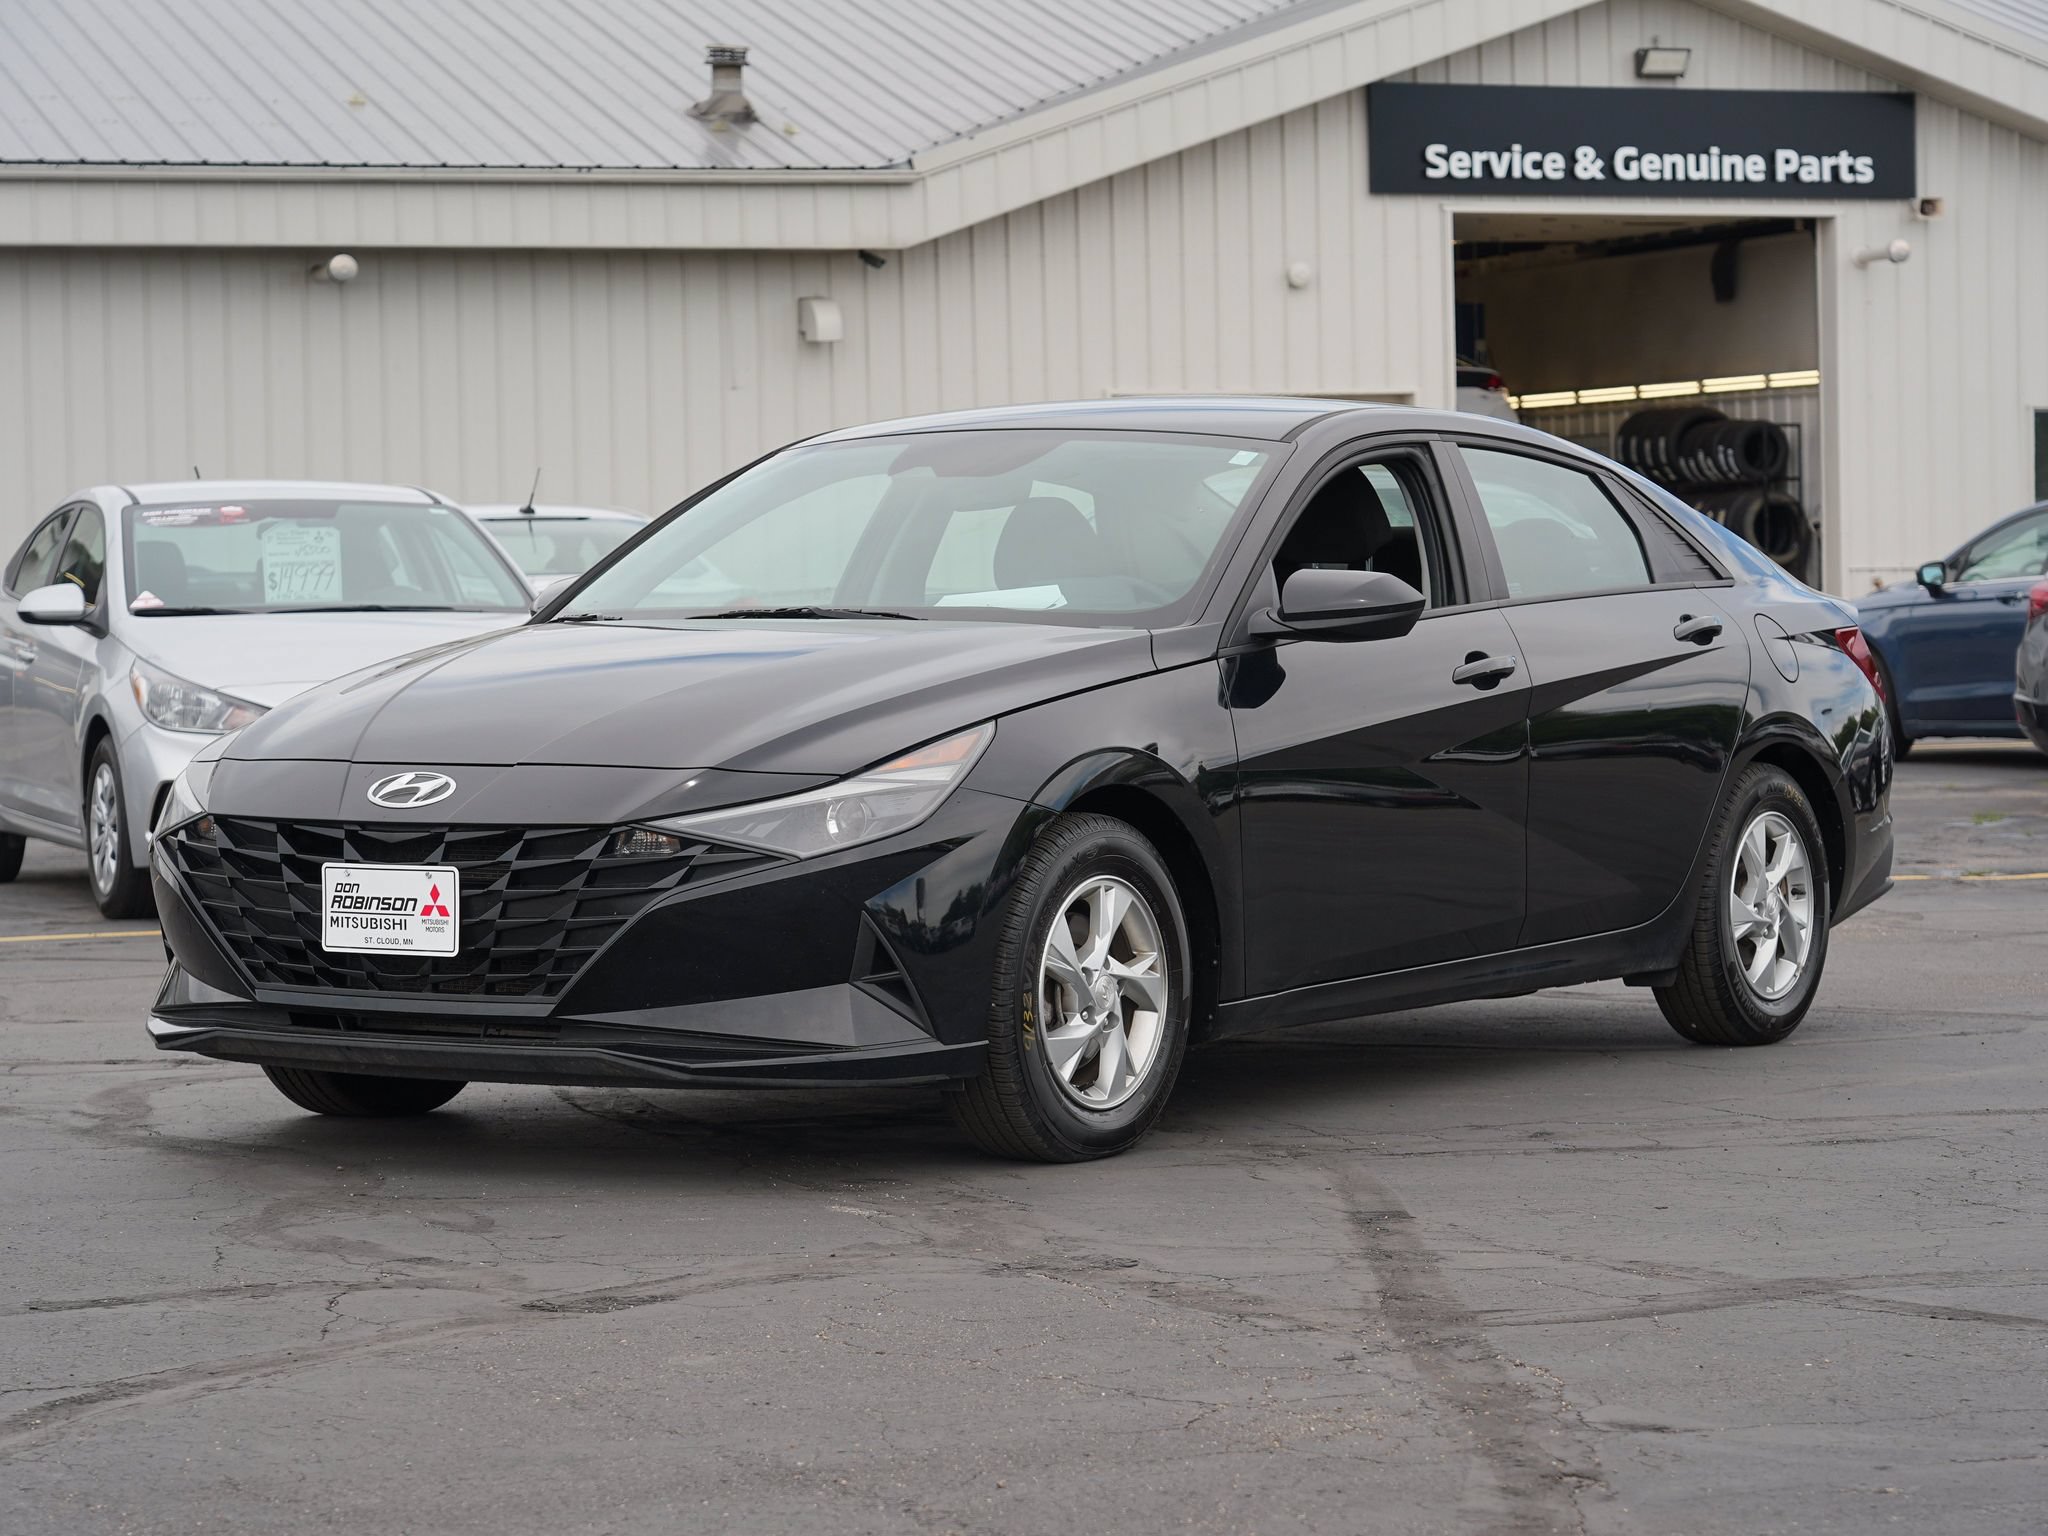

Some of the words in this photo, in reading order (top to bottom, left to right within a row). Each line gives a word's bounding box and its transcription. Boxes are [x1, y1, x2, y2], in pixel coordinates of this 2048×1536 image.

[1424, 143, 1566, 180] Service
[1574, 145, 1606, 180] &
[1613, 146, 1766, 183] Genuine
[1774, 148, 1876, 184] Parts
[334, 882, 360, 894] DON
[330, 894, 418, 912] ROBINSON
[330, 915, 408, 931] MITSUBISHI
[421, 918, 449, 926] MITSUBISHI
[425, 926, 445, 934] MOTORS
[364, 936, 376, 945] ST.
[403, 938, 414, 946] MN
